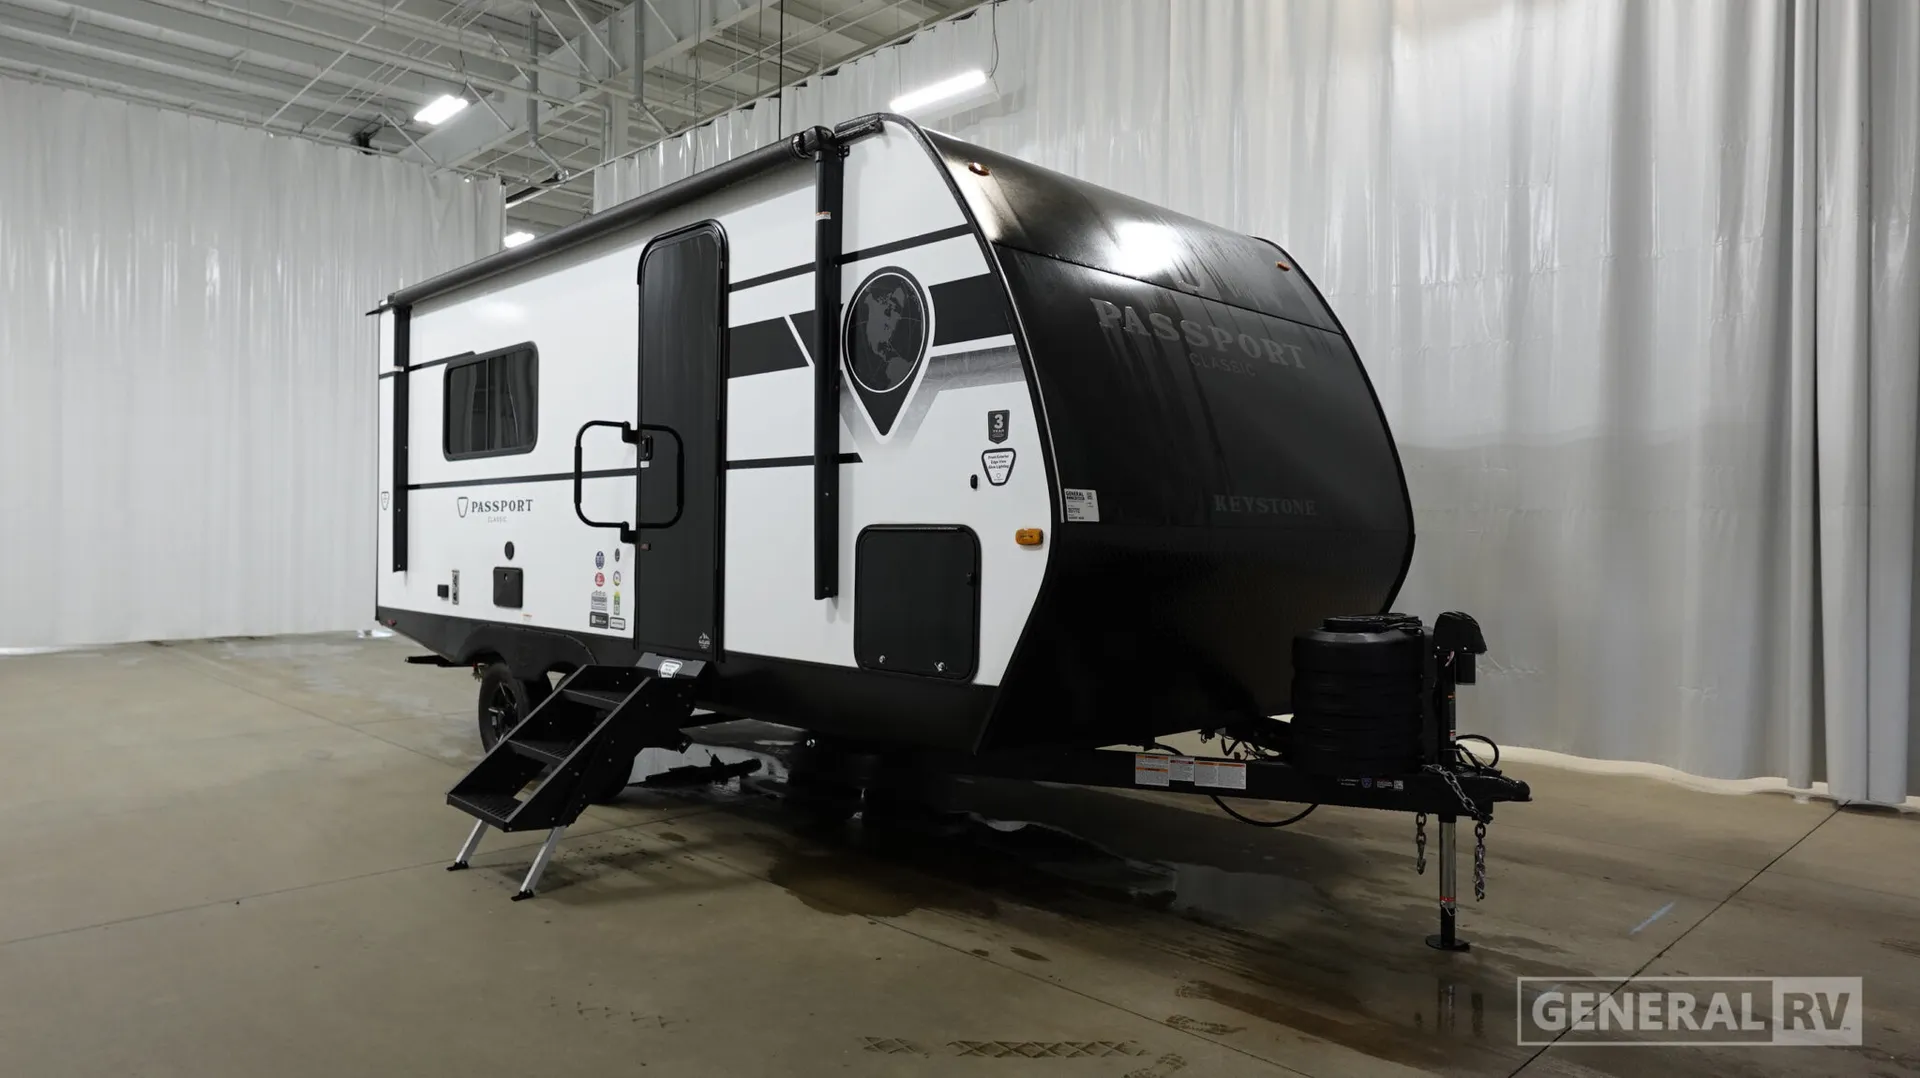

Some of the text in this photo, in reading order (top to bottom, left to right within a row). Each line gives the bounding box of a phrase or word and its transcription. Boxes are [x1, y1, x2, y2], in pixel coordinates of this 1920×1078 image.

[1089, 297, 1306, 369] PASSPORT
[1189, 352, 1256, 377] CLASSIC
[994, 414, 1003, 429] 3
[471, 499, 534, 513] PASSPORT
[1213, 494, 1318, 516] KEYSTONE
[487, 515, 508, 524] CLASSIC
